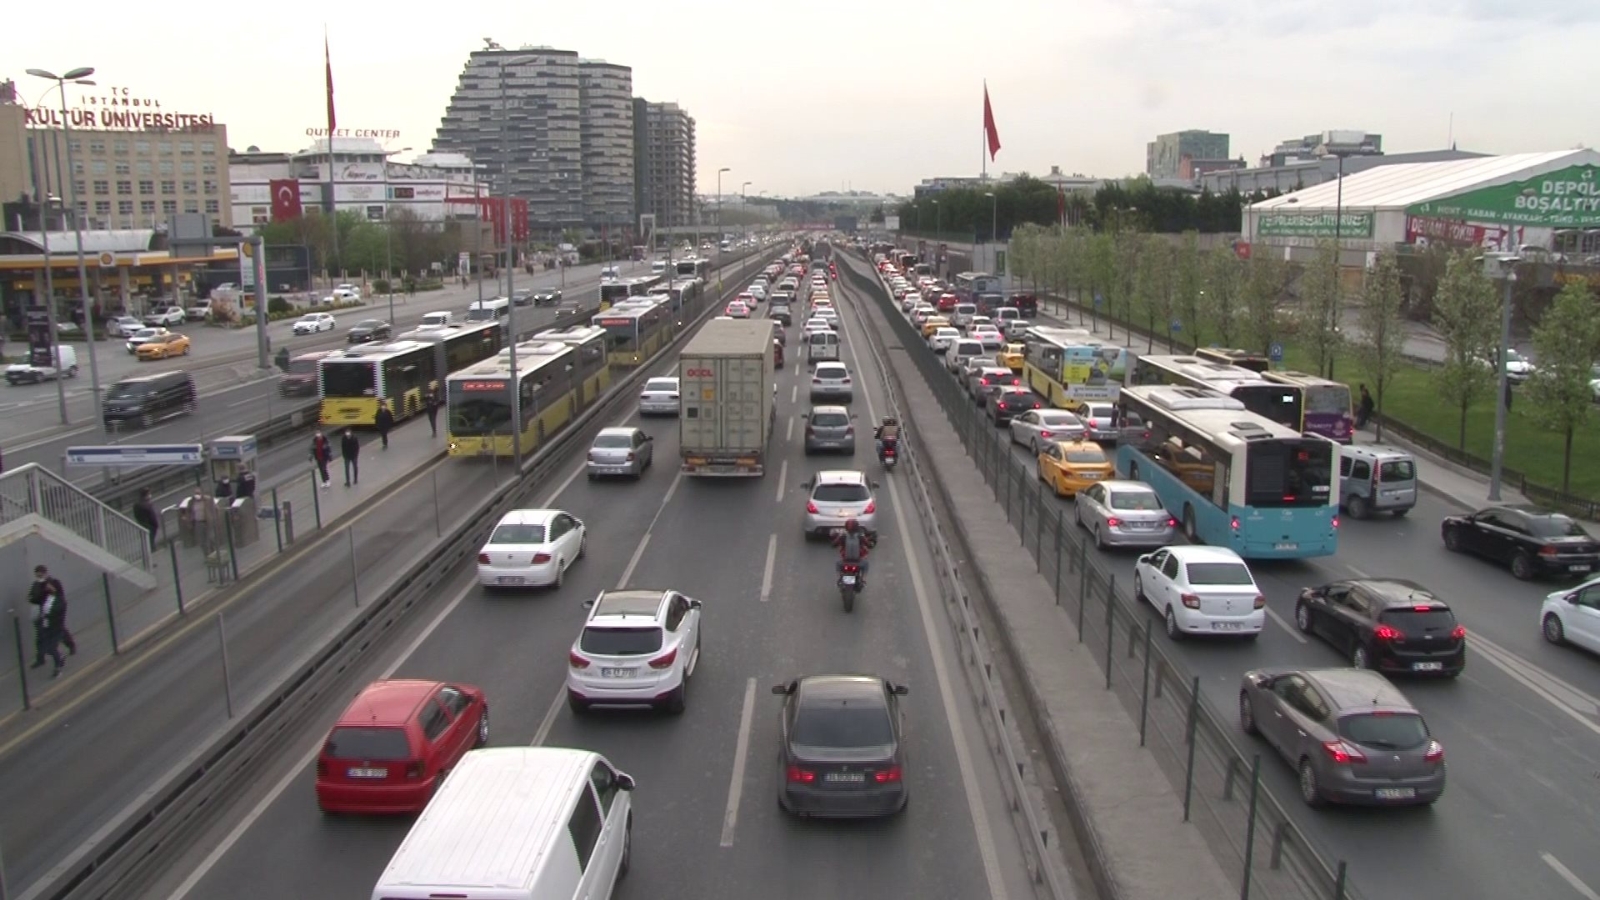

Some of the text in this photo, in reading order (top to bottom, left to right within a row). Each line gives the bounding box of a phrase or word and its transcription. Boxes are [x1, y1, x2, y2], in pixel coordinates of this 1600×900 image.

[82, 95, 161, 108] İSTANBUL
[25, 106, 215, 130] KÜLTÜR ÜNİVERSİTESİ
[305, 128, 400, 138] OUTET CENTER
[1541, 181, 1600, 196] DEPOL
[1467, 208, 1496, 218] KABAN
